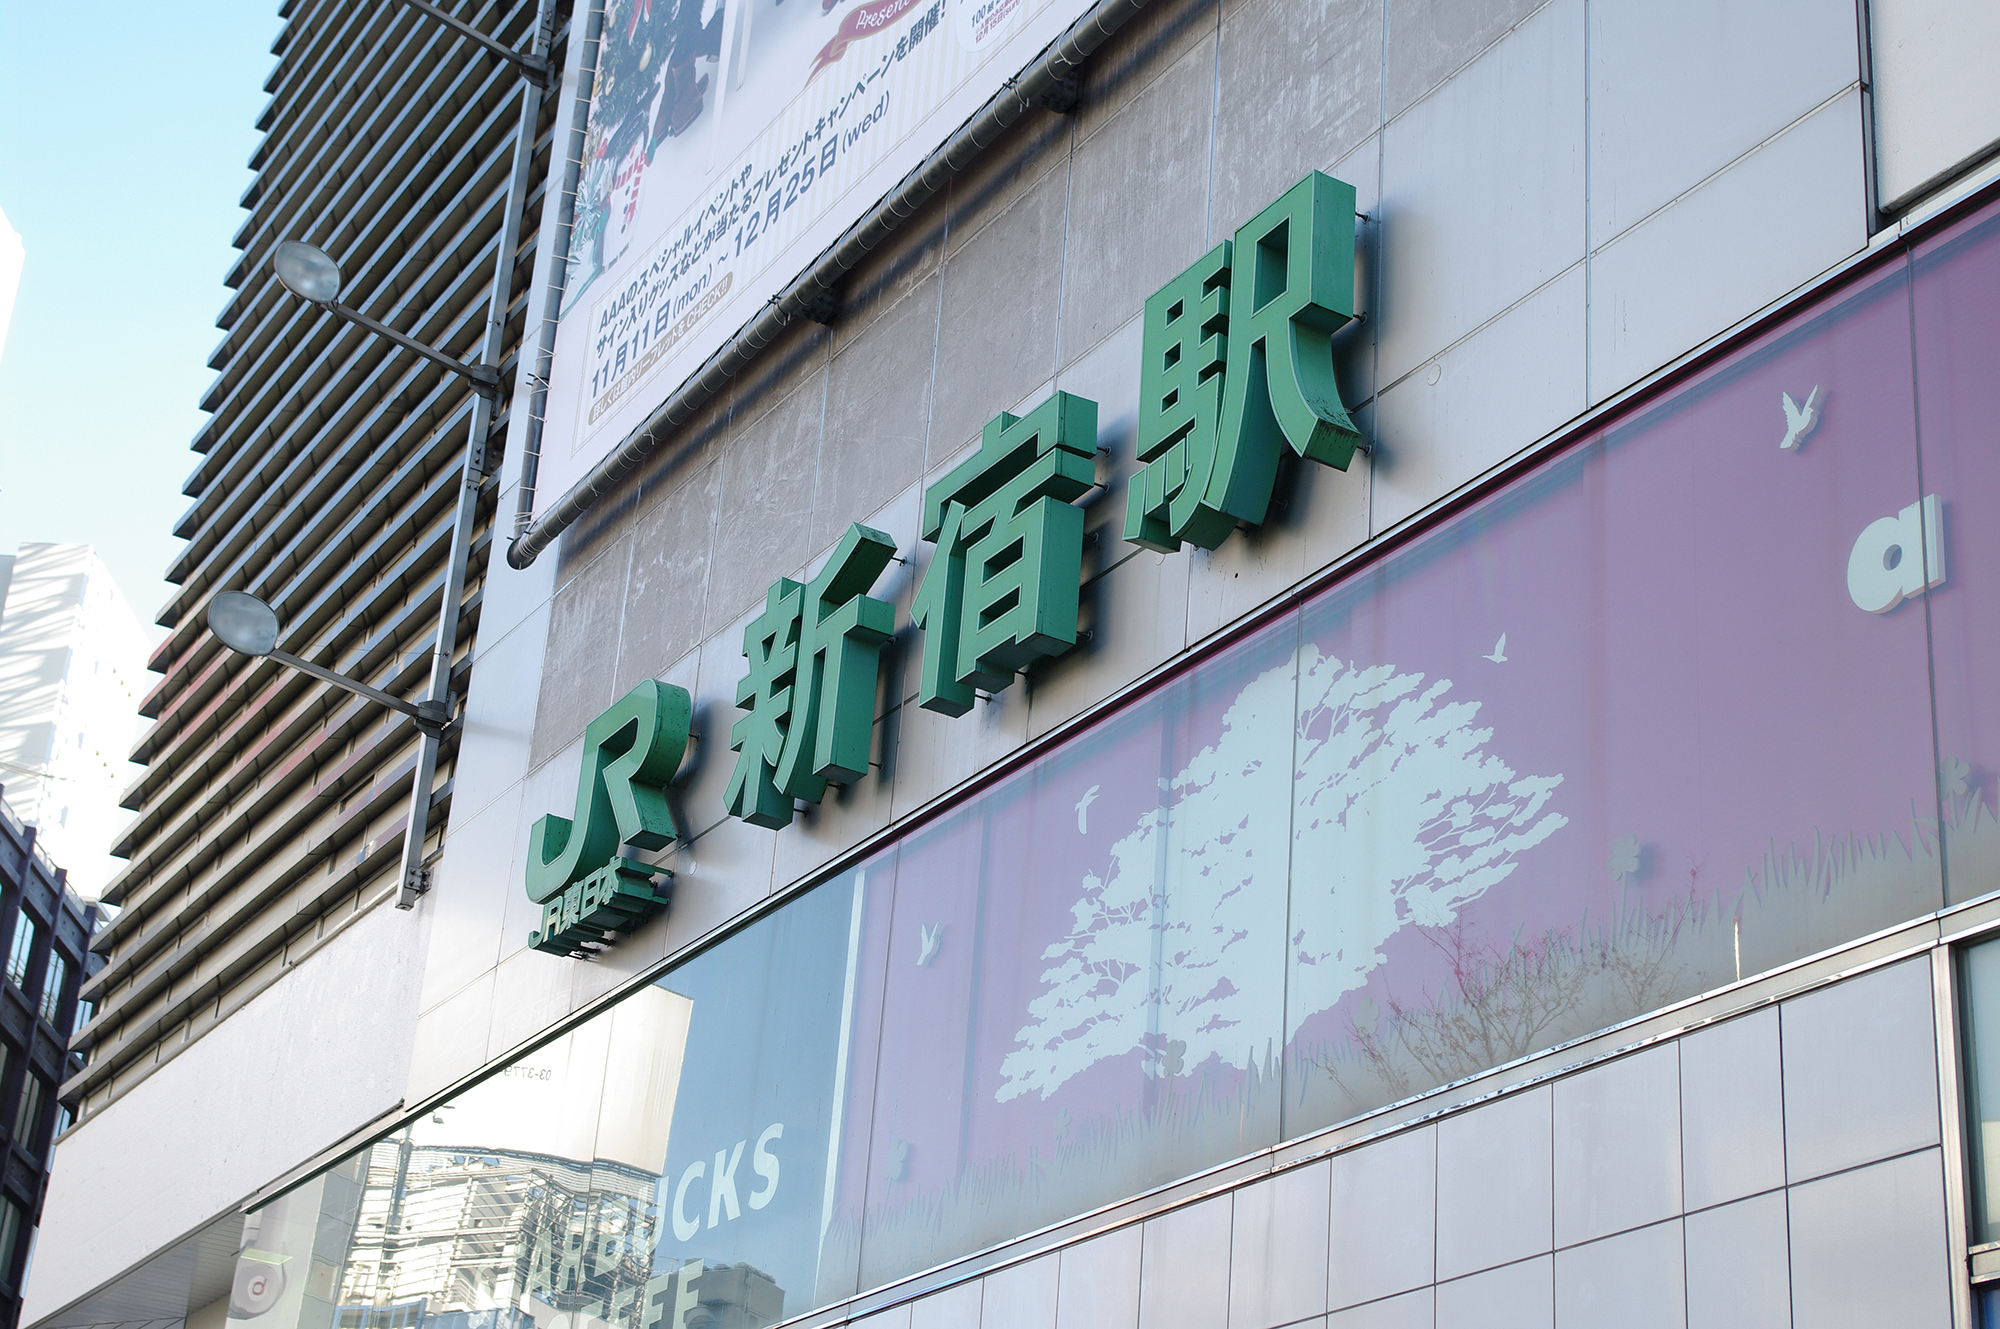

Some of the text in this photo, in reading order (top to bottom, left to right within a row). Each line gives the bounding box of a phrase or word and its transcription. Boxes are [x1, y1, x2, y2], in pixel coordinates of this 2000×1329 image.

[598, 163, 752, 334] AAAのスペシャルイベントや
[528, 856, 622, 950] JR東日本
